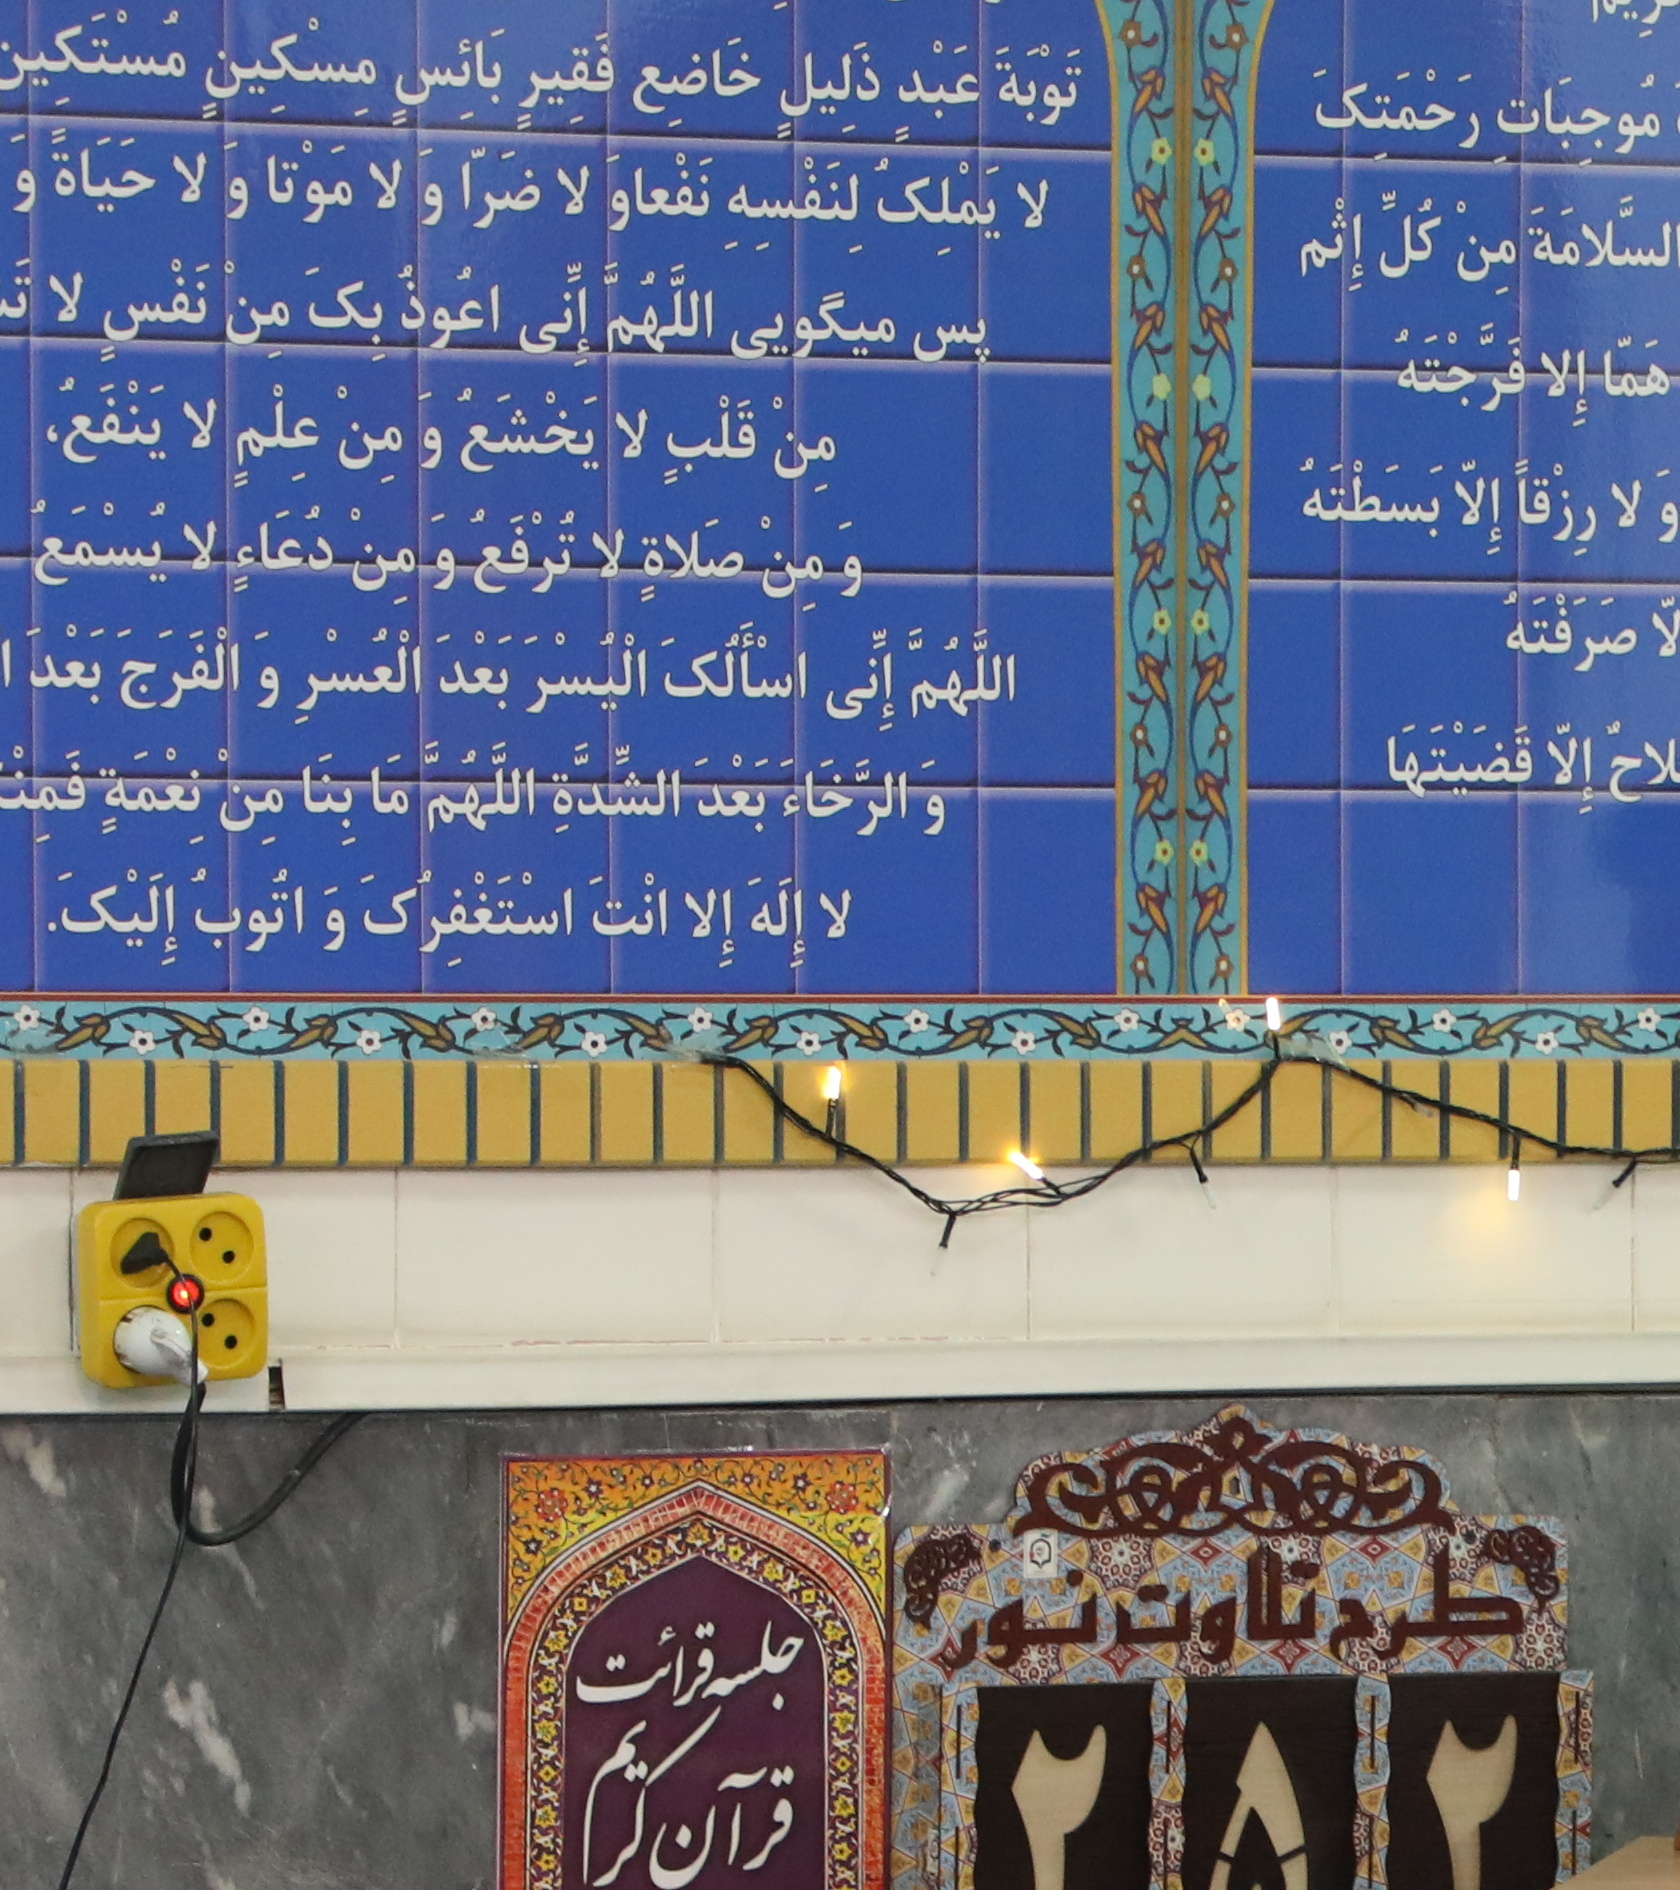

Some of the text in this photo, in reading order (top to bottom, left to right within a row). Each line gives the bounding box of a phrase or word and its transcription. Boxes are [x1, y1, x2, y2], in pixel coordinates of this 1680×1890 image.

[173, 153, 206, 202] لا
[369, 160, 402, 208] لا
[557, 166, 589, 214] لا
[1017, 179, 1048, 227] لا
[49, 272, 83, 321] لا
[731, 292, 895, 359] میگویی
[913, 318, 986, 365] پس
[183, 398, 216, 448] لا
[615, 409, 648, 457] لا
[1611, 480, 1642, 527] لا
[184, 521, 216, 570] لا
[592, 529, 624, 578] لا
[820, 889, 851, 938] لا
[944, 1569, 1099, 1670] نور
[1119, 1544, 1321, 1666] تلاوت
[702, 1620, 804, 1711] جلسه
[583, 1705, 794, 1890] قرآن کریم
